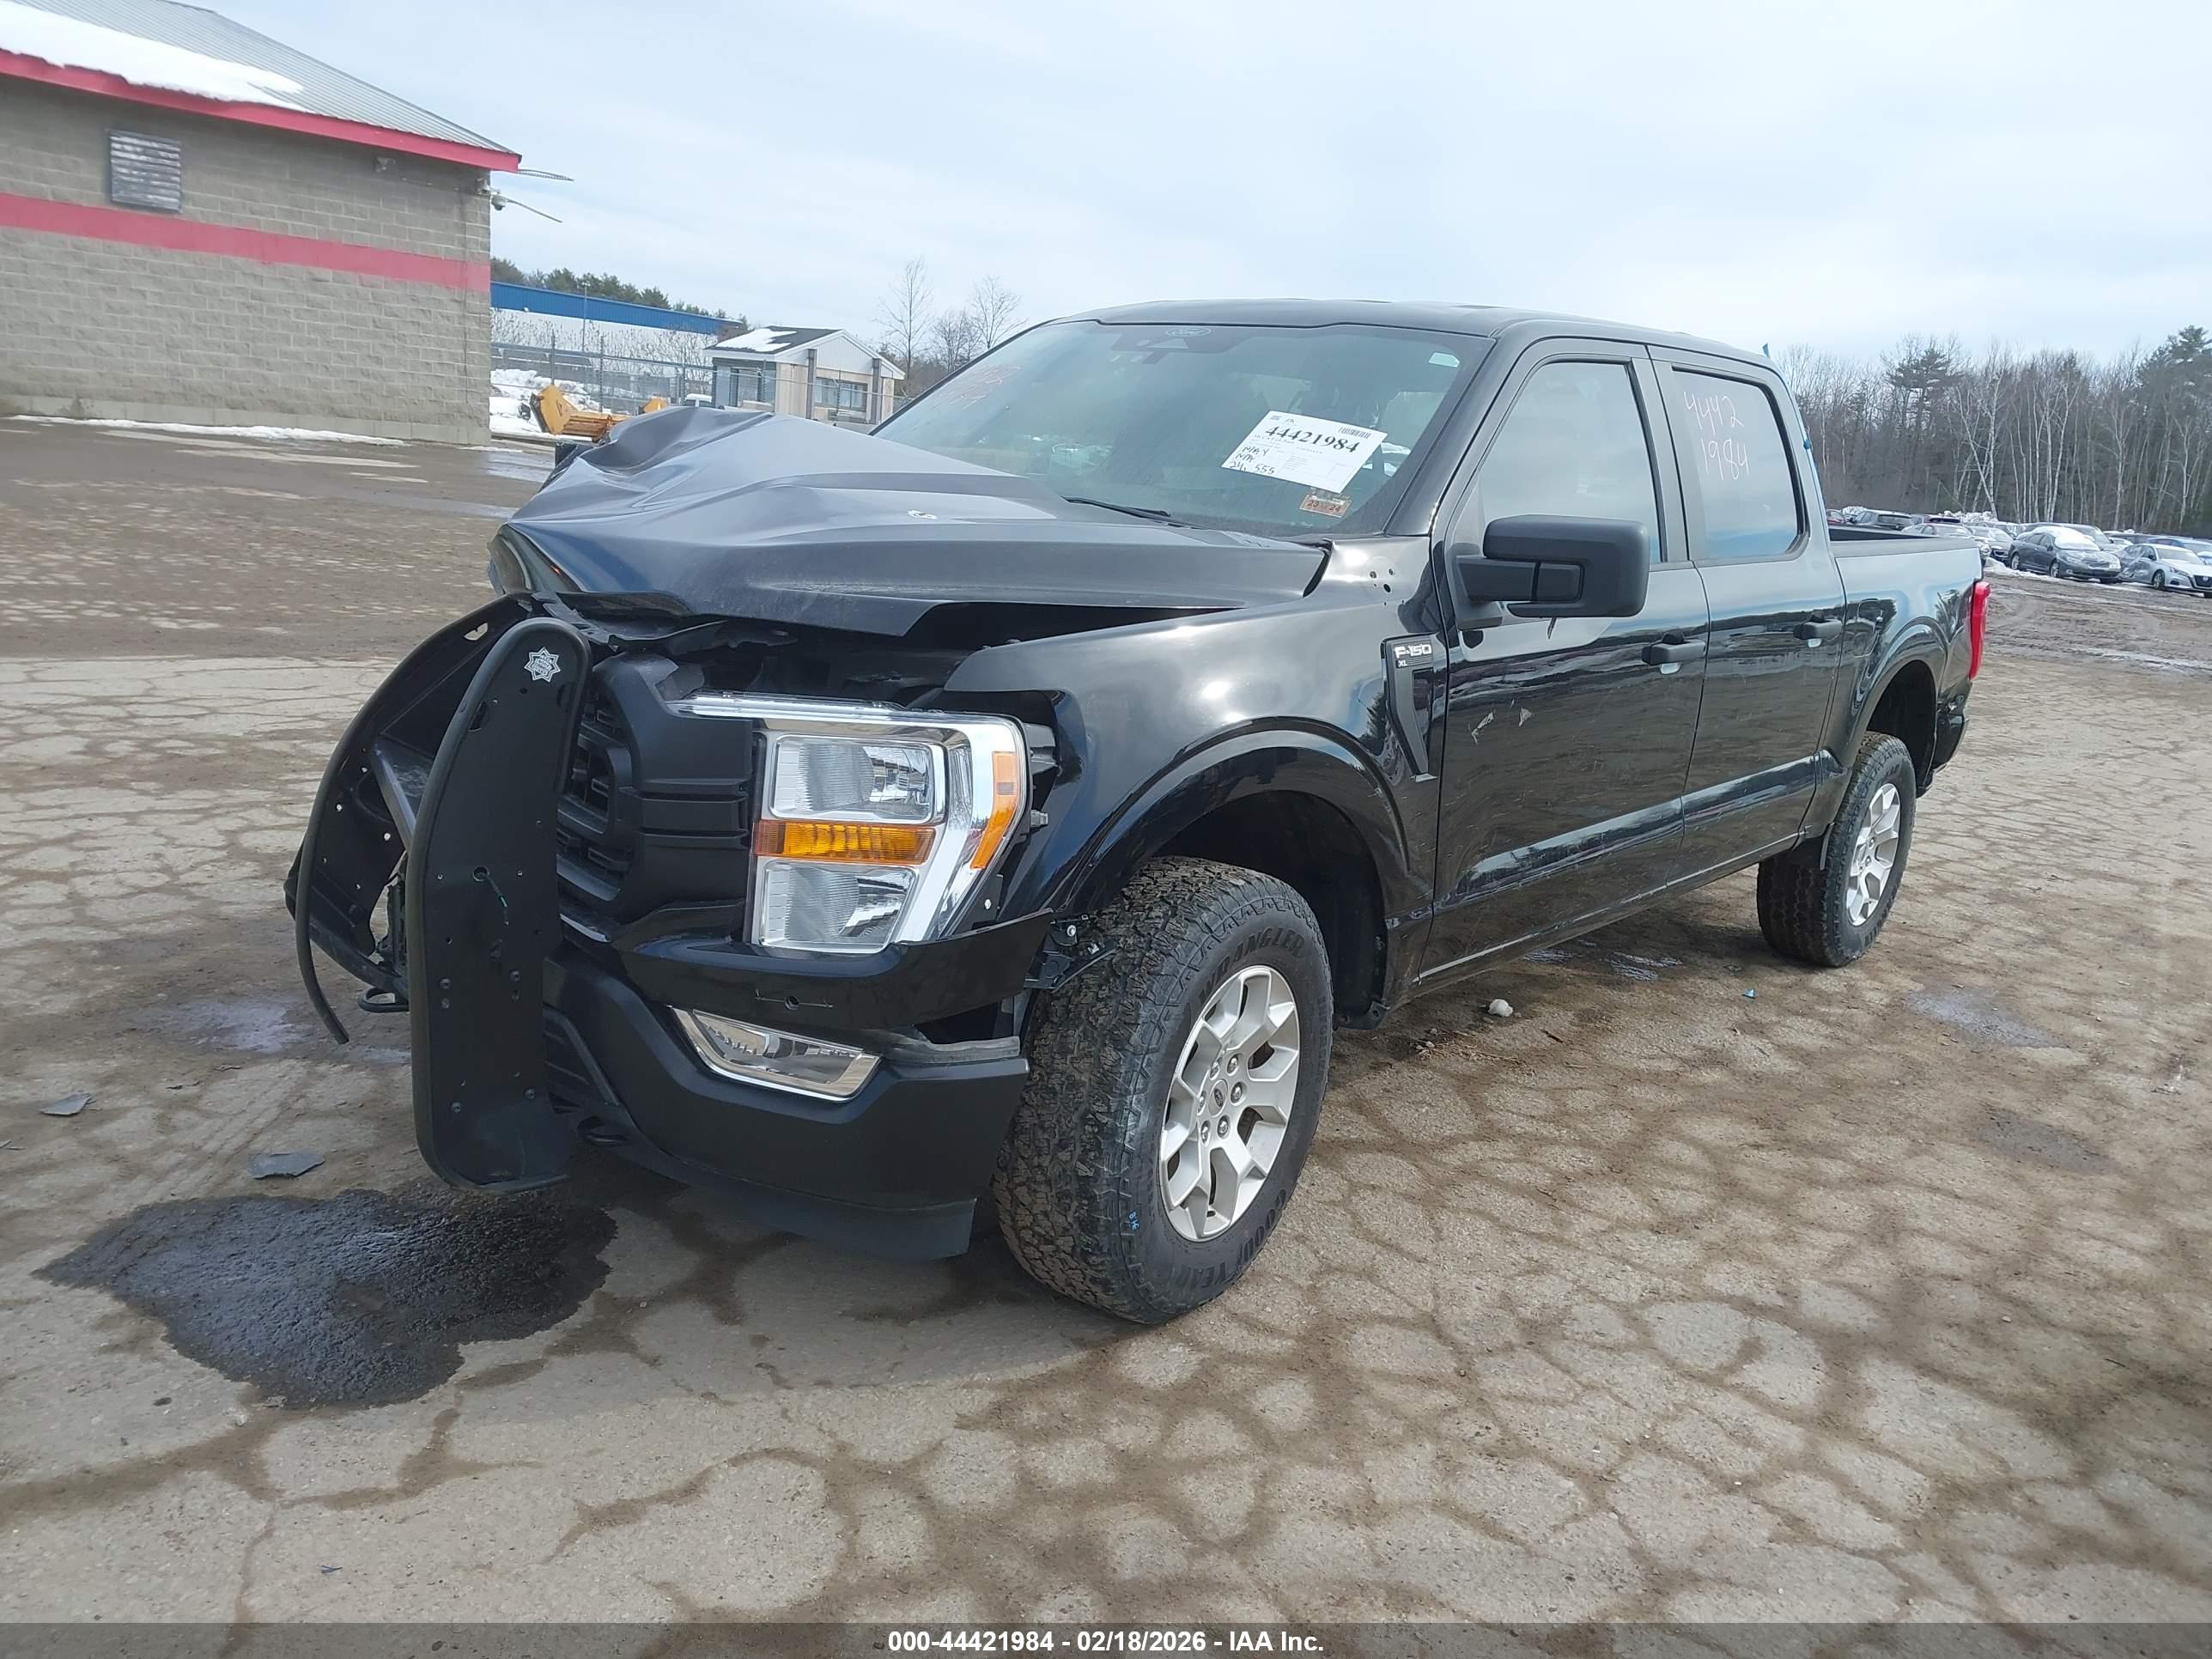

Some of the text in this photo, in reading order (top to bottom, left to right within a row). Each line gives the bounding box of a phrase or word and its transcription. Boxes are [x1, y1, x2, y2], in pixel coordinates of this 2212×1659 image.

[1684, 391, 1745, 436] 4442
[1265, 426, 1361, 453] 44421984
[1700, 437, 1749, 481] 1984
[1394, 644, 1432, 659] F-150
